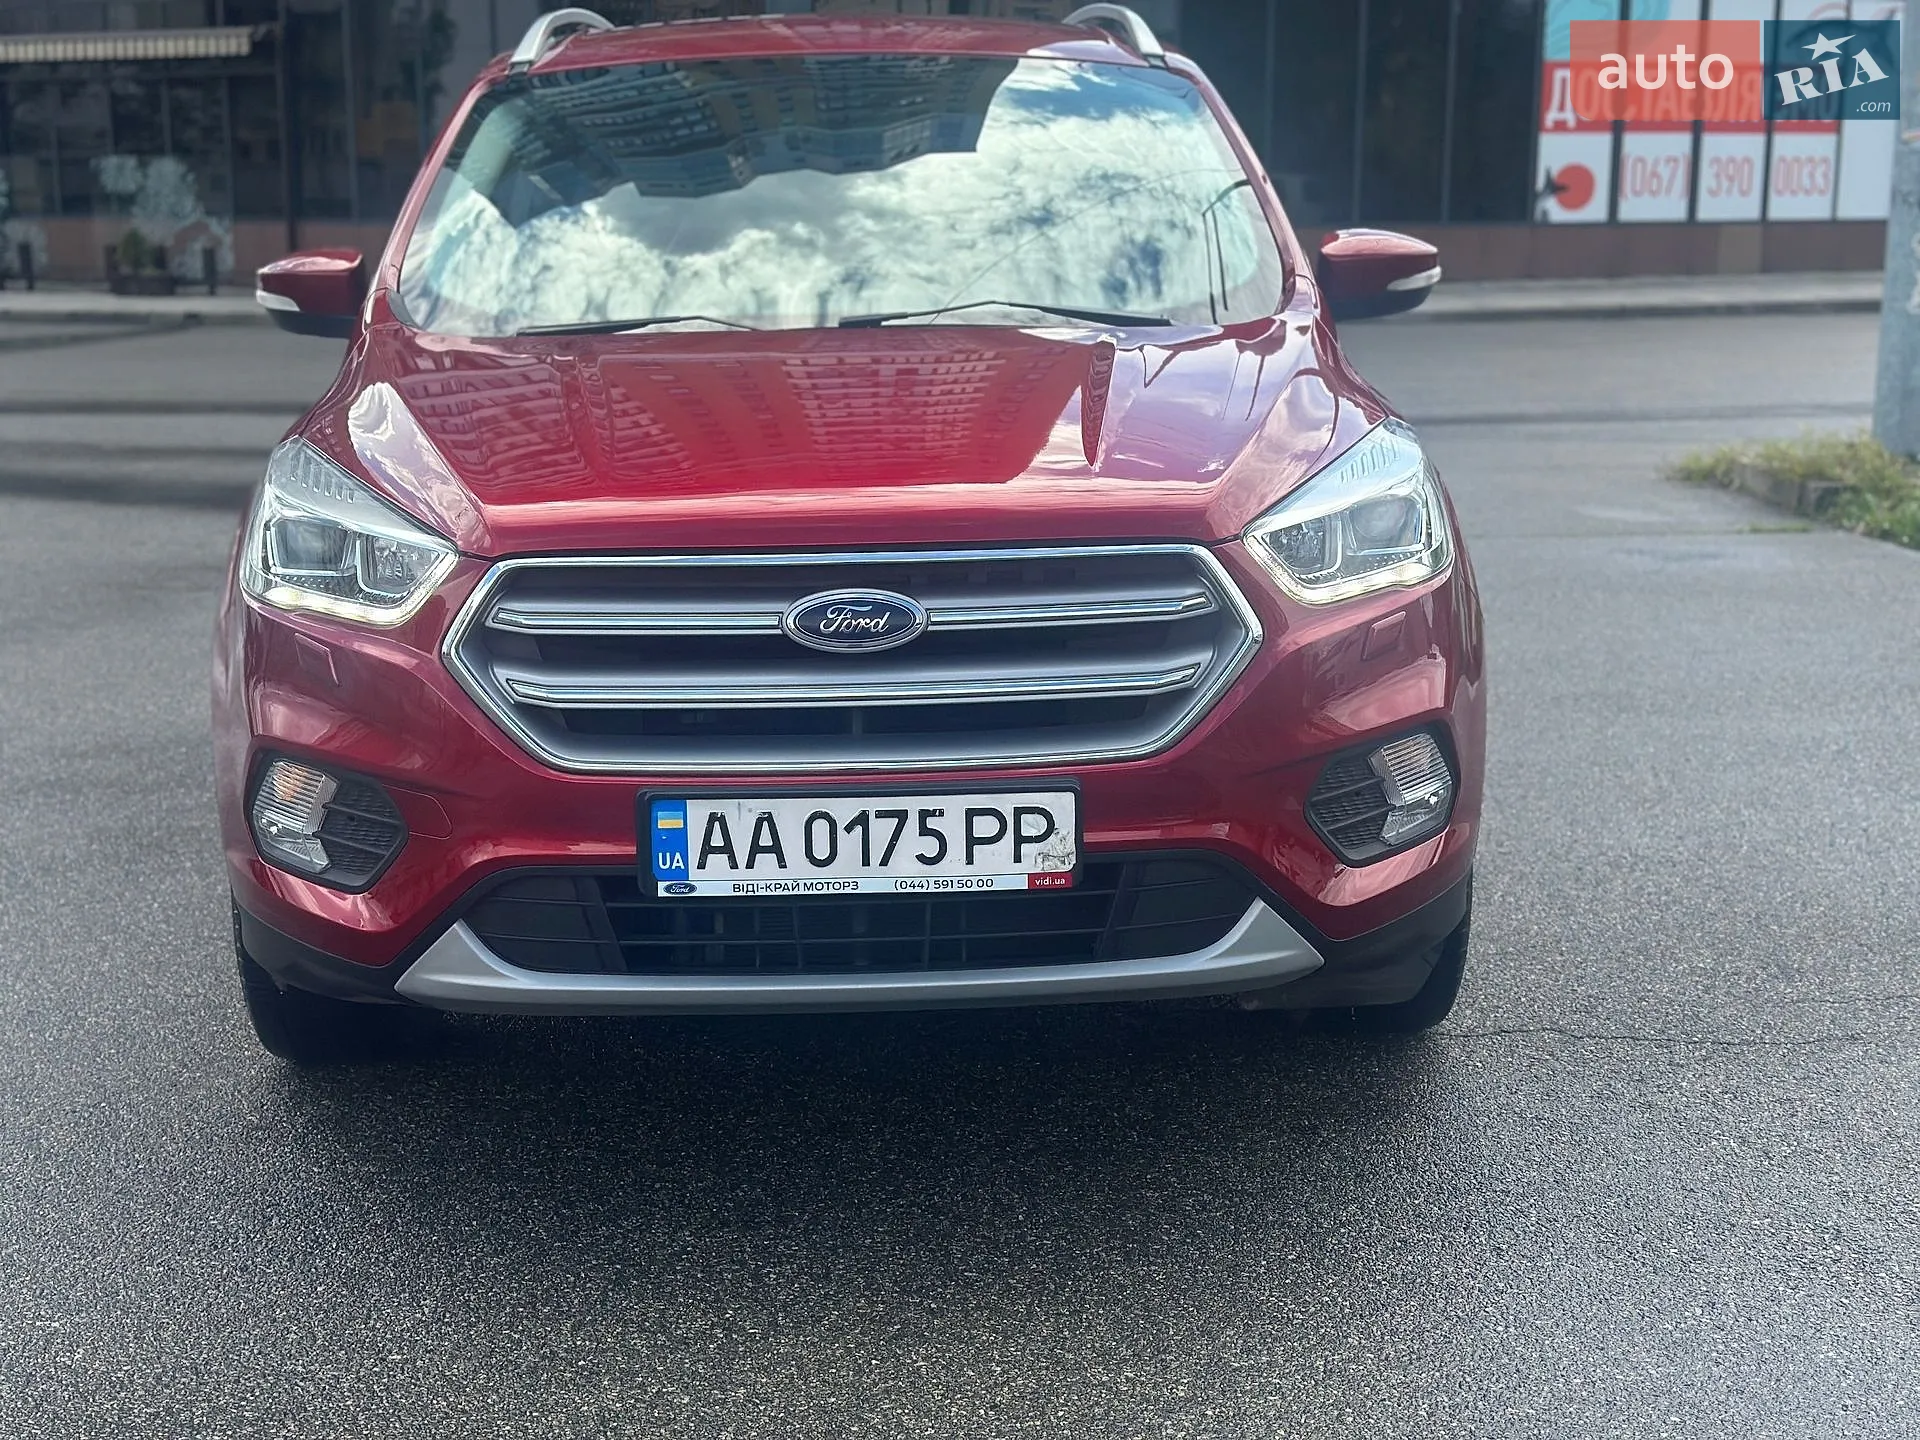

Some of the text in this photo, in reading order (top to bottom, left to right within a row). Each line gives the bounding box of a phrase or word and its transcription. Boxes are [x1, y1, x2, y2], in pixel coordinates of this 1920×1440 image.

[1620, 152, 1831, 201] (067) 390 0033
[820, 604, 891, 634] Ford
[696, 806, 1056, 870] AA 0175 PP
[658, 852, 685, 870] UA
[670, 884, 690, 893] Ford
[732, 879, 860, 894] ВІДІ-КРАЙ МОТОРЗ
[893, 878, 994, 891] (044) 591 50 00
[1033, 876, 1066, 887] vidi.ua
